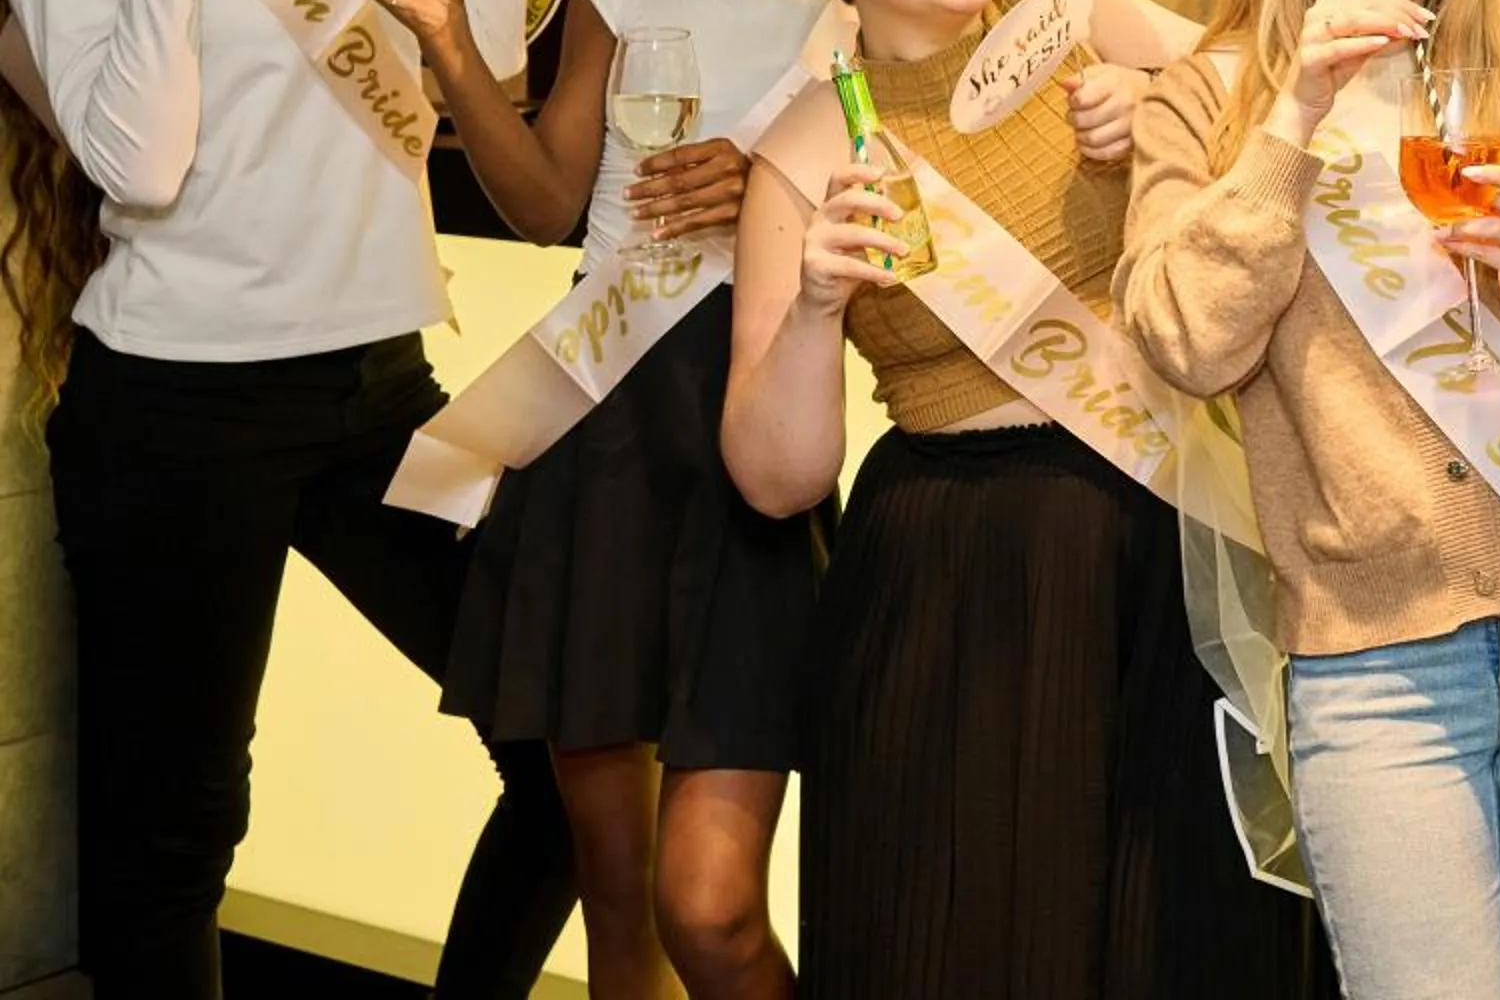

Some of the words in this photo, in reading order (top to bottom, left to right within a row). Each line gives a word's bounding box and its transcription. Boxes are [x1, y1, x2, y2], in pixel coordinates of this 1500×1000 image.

[327, 25, 425, 157] Bride
[969, 56, 1010, 101] She
[1010, 318, 1170, 456] Bride
